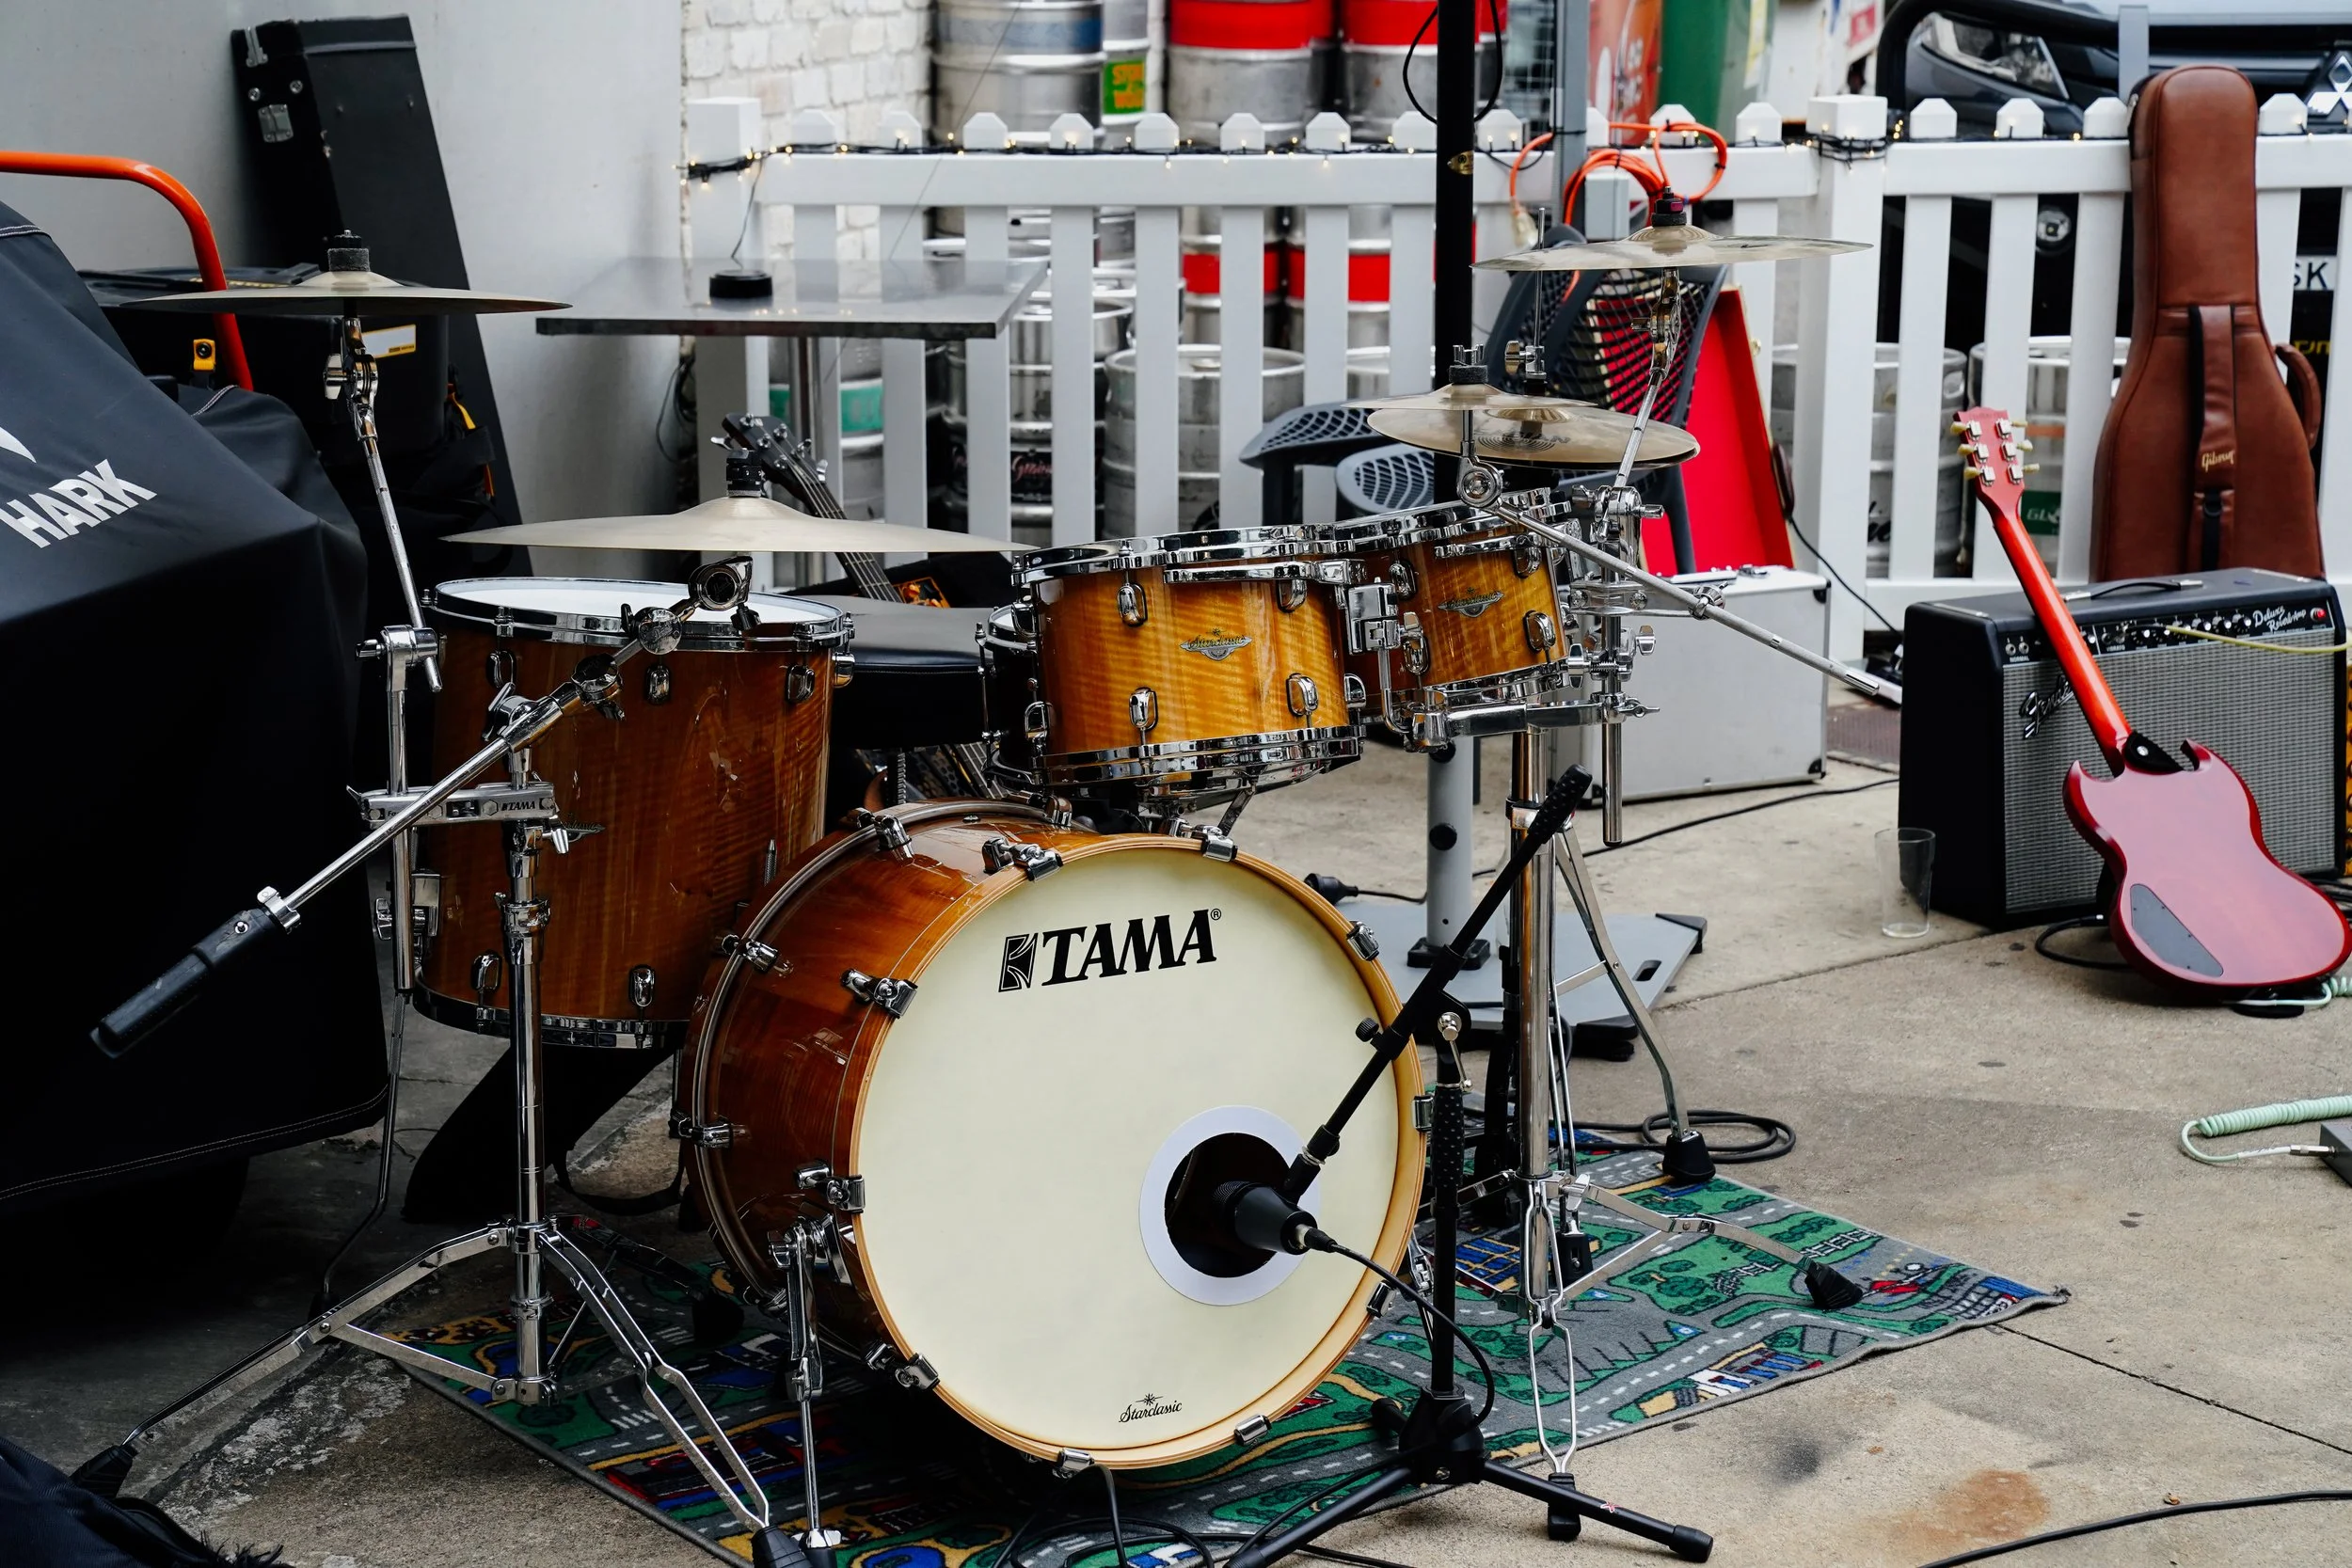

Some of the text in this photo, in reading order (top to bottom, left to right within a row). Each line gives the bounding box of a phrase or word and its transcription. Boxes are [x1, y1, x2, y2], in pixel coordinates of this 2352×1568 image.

[2252, 605, 2285, 628] Deluxe
[509, 800, 535, 811] TAMA
[1119, 1400, 1183, 1422] Starclassic
